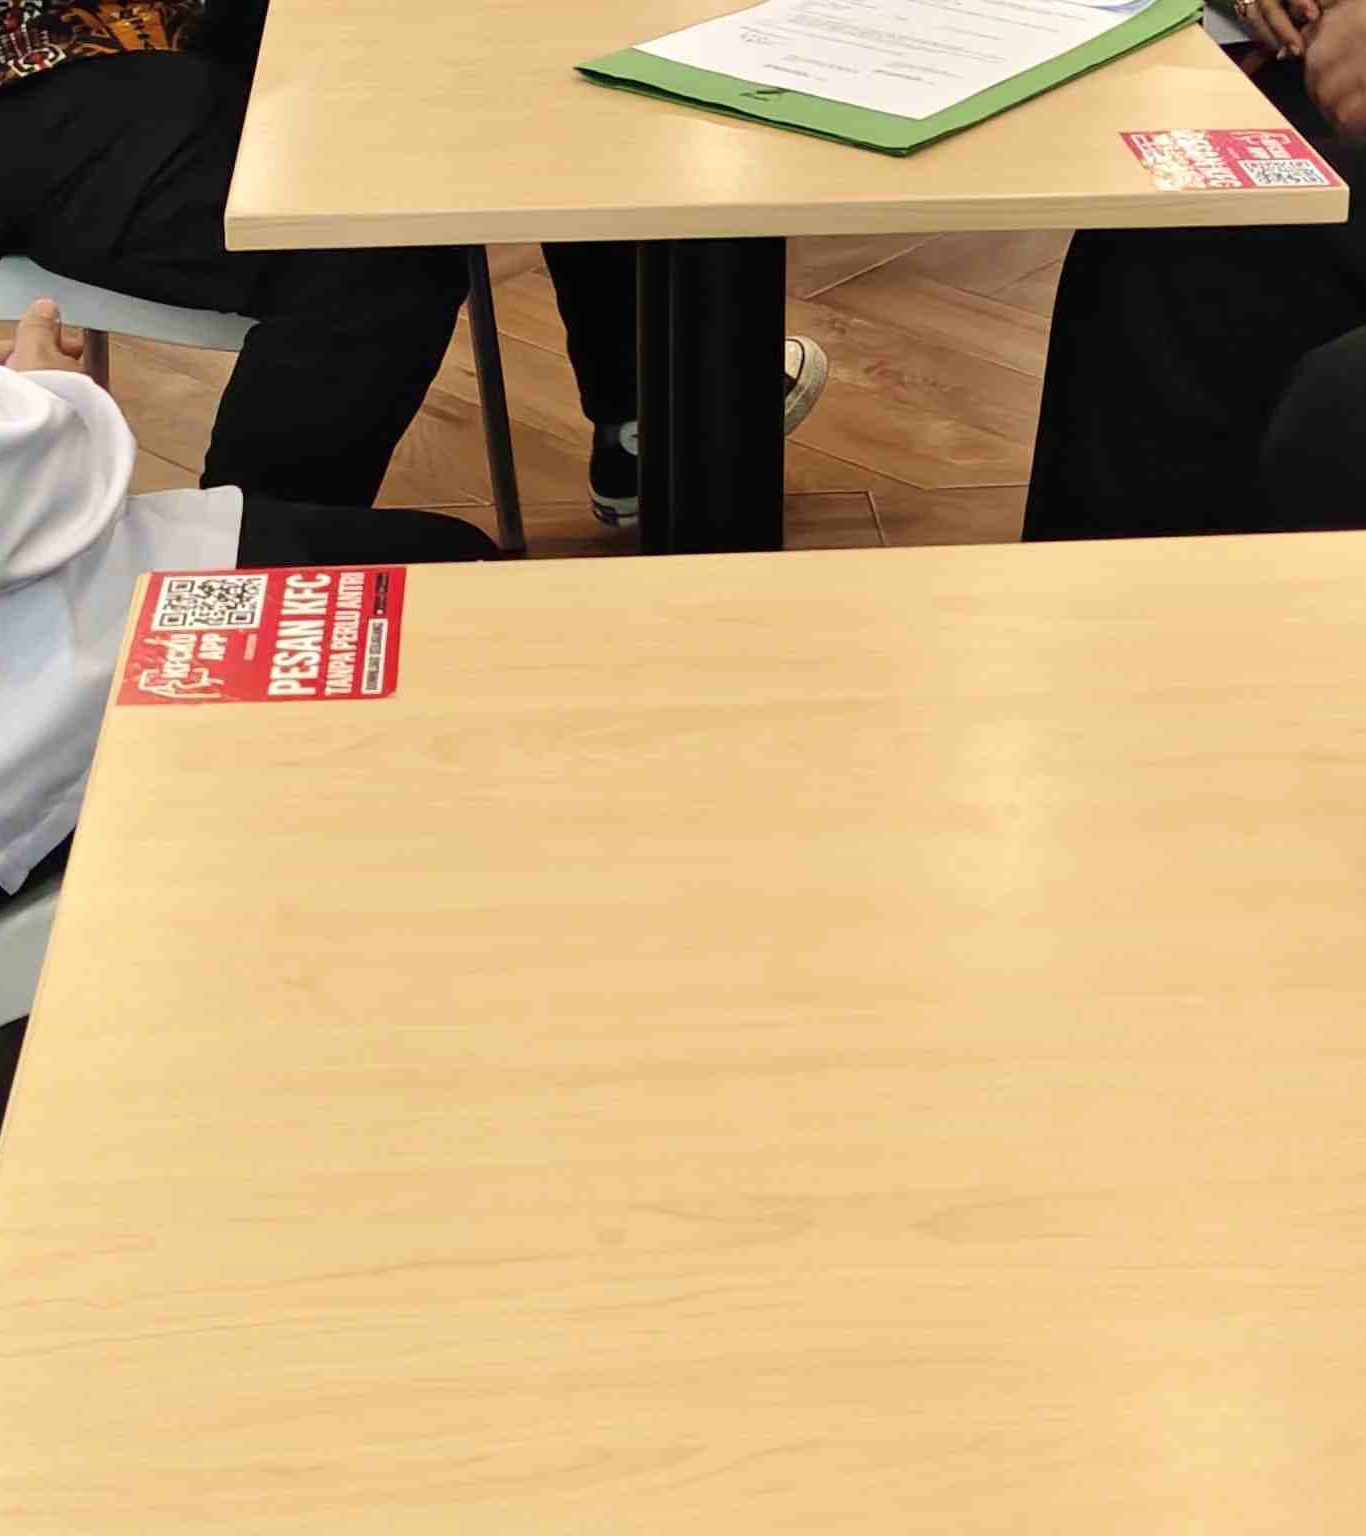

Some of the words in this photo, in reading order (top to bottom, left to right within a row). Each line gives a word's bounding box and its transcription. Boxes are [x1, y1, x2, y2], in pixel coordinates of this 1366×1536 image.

[280, 573, 332, 616] KFC
[336, 571, 365, 609] ANTRI
[198, 633, 228, 662] APP
[329, 610, 361, 651] PERLU
[267, 619, 327, 696] PESAN
[324, 651, 357, 696] TANPA
